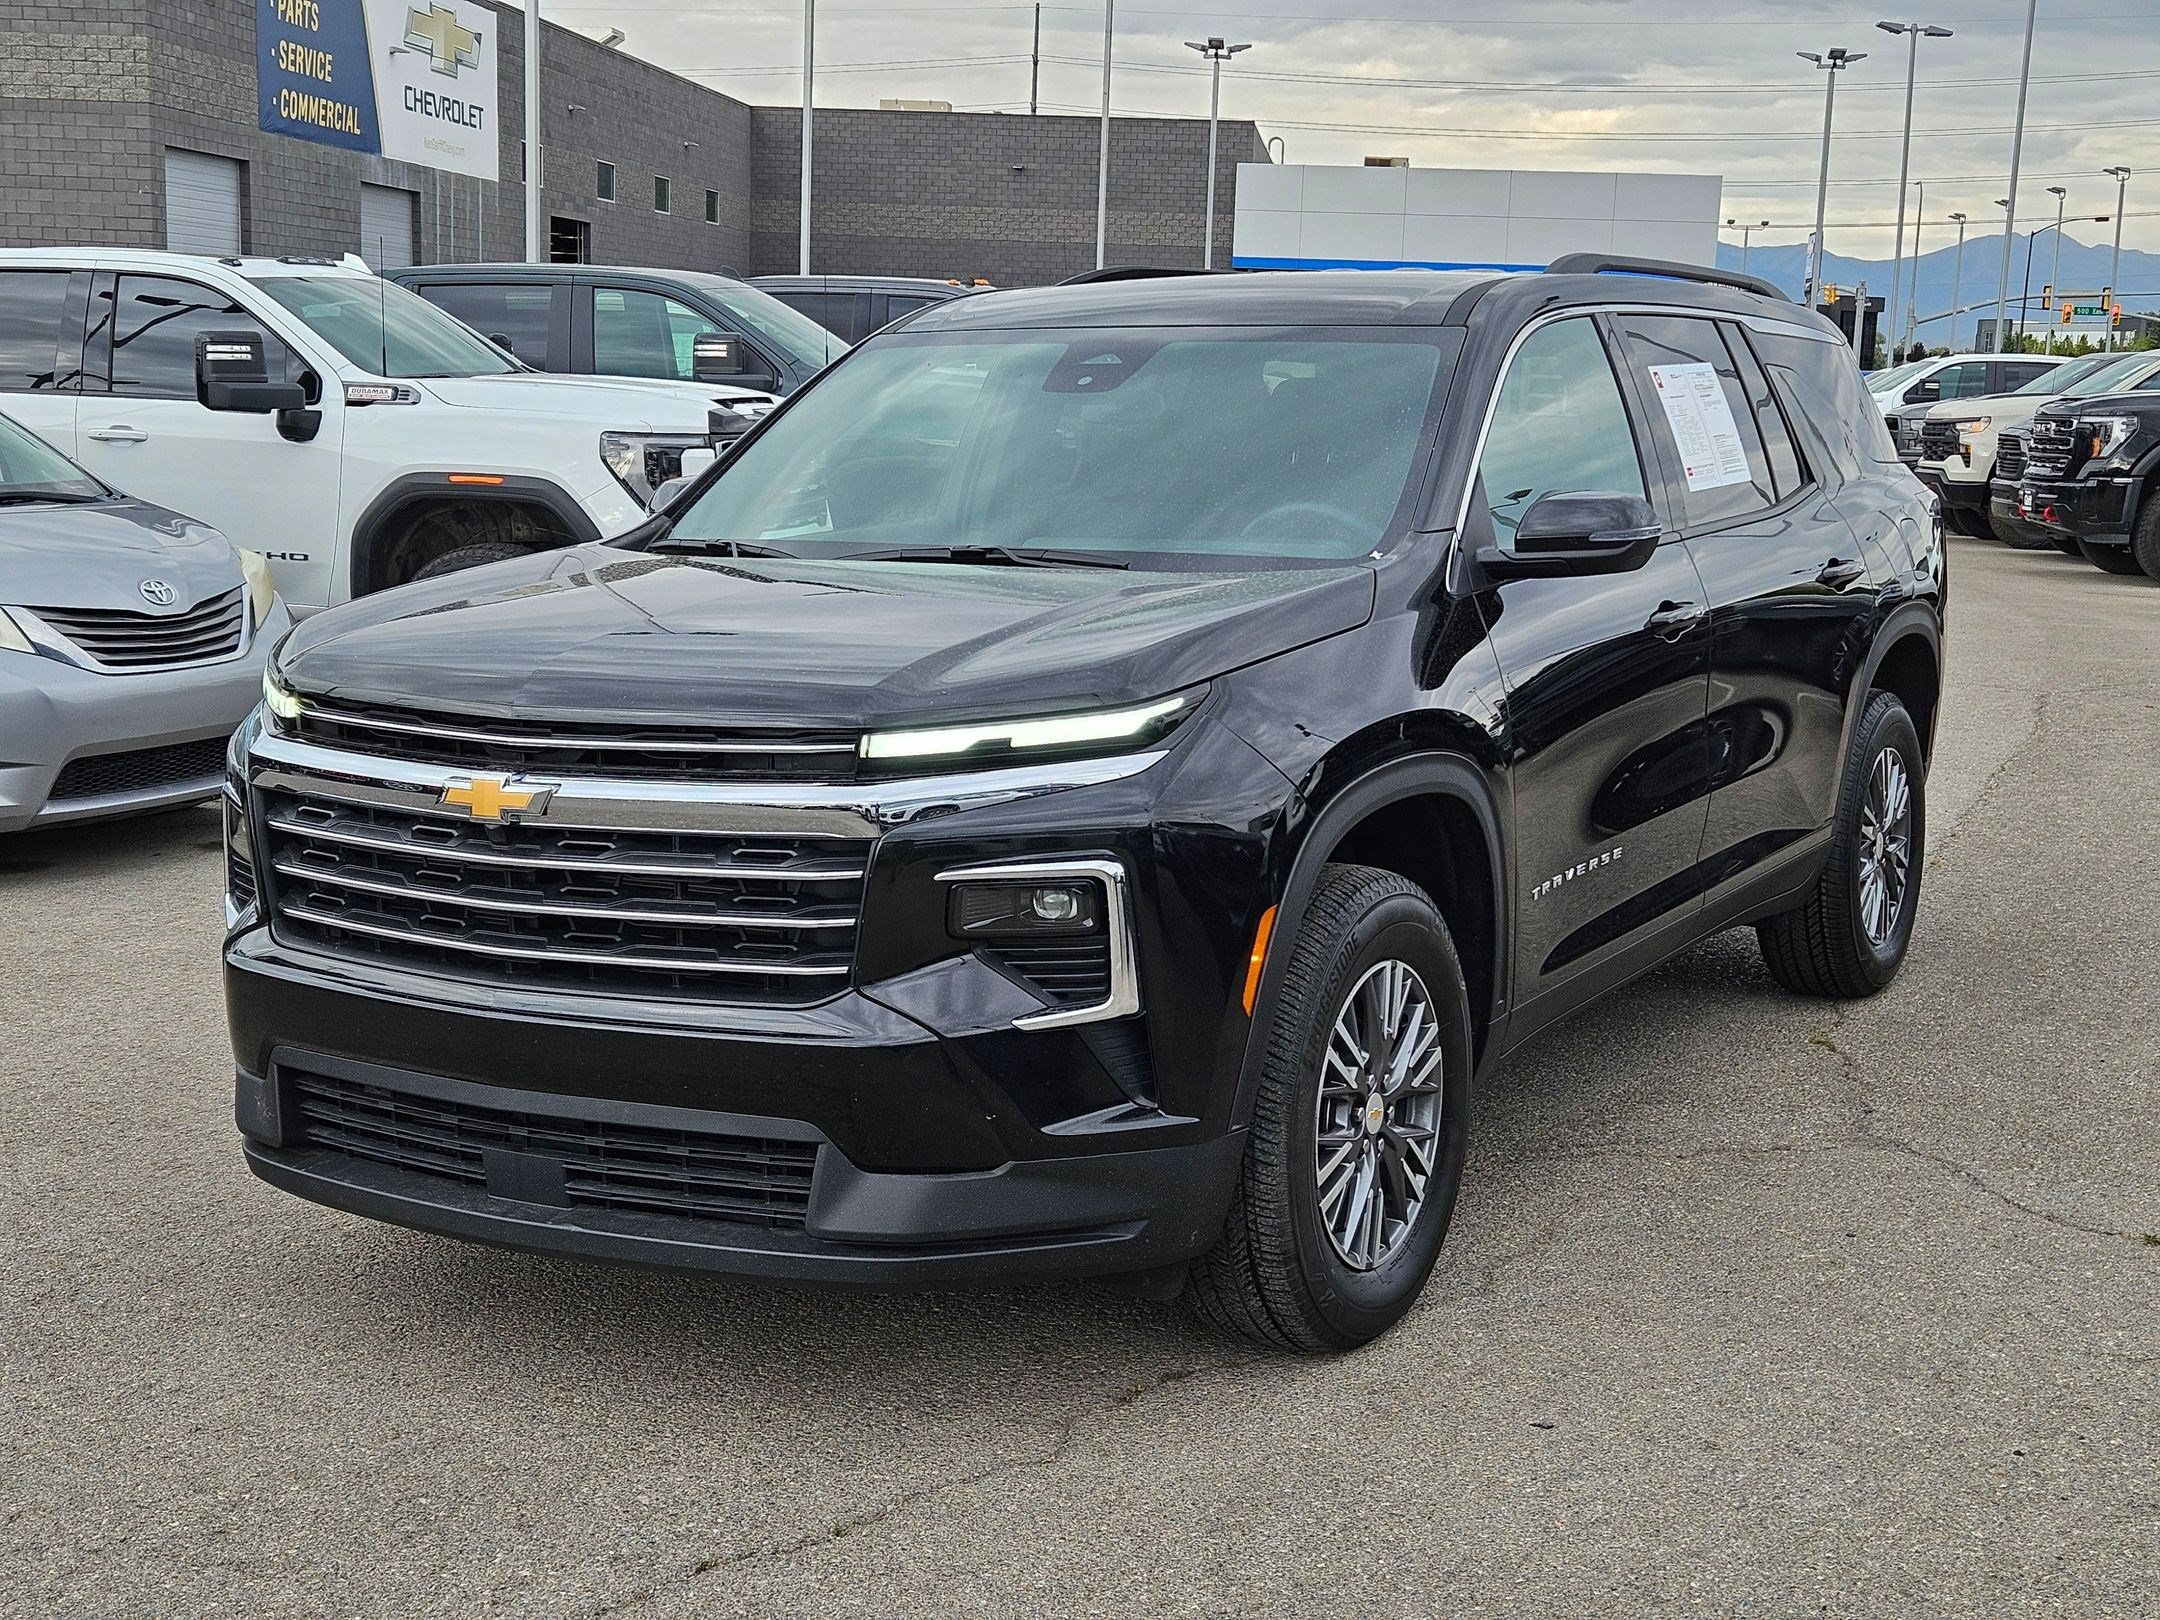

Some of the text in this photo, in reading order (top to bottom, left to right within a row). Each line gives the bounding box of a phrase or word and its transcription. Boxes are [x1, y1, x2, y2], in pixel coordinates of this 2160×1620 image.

[278, 0, 319, 32] PARTS
[278, 39, 333, 83] SERVICE
[280, 88, 361, 135] COMMERCIAL
[403, 85, 484, 130] CHEVROLET
[252, 550, 310, 561] HD
[1531, 847, 1622, 900] TRAVERSE
